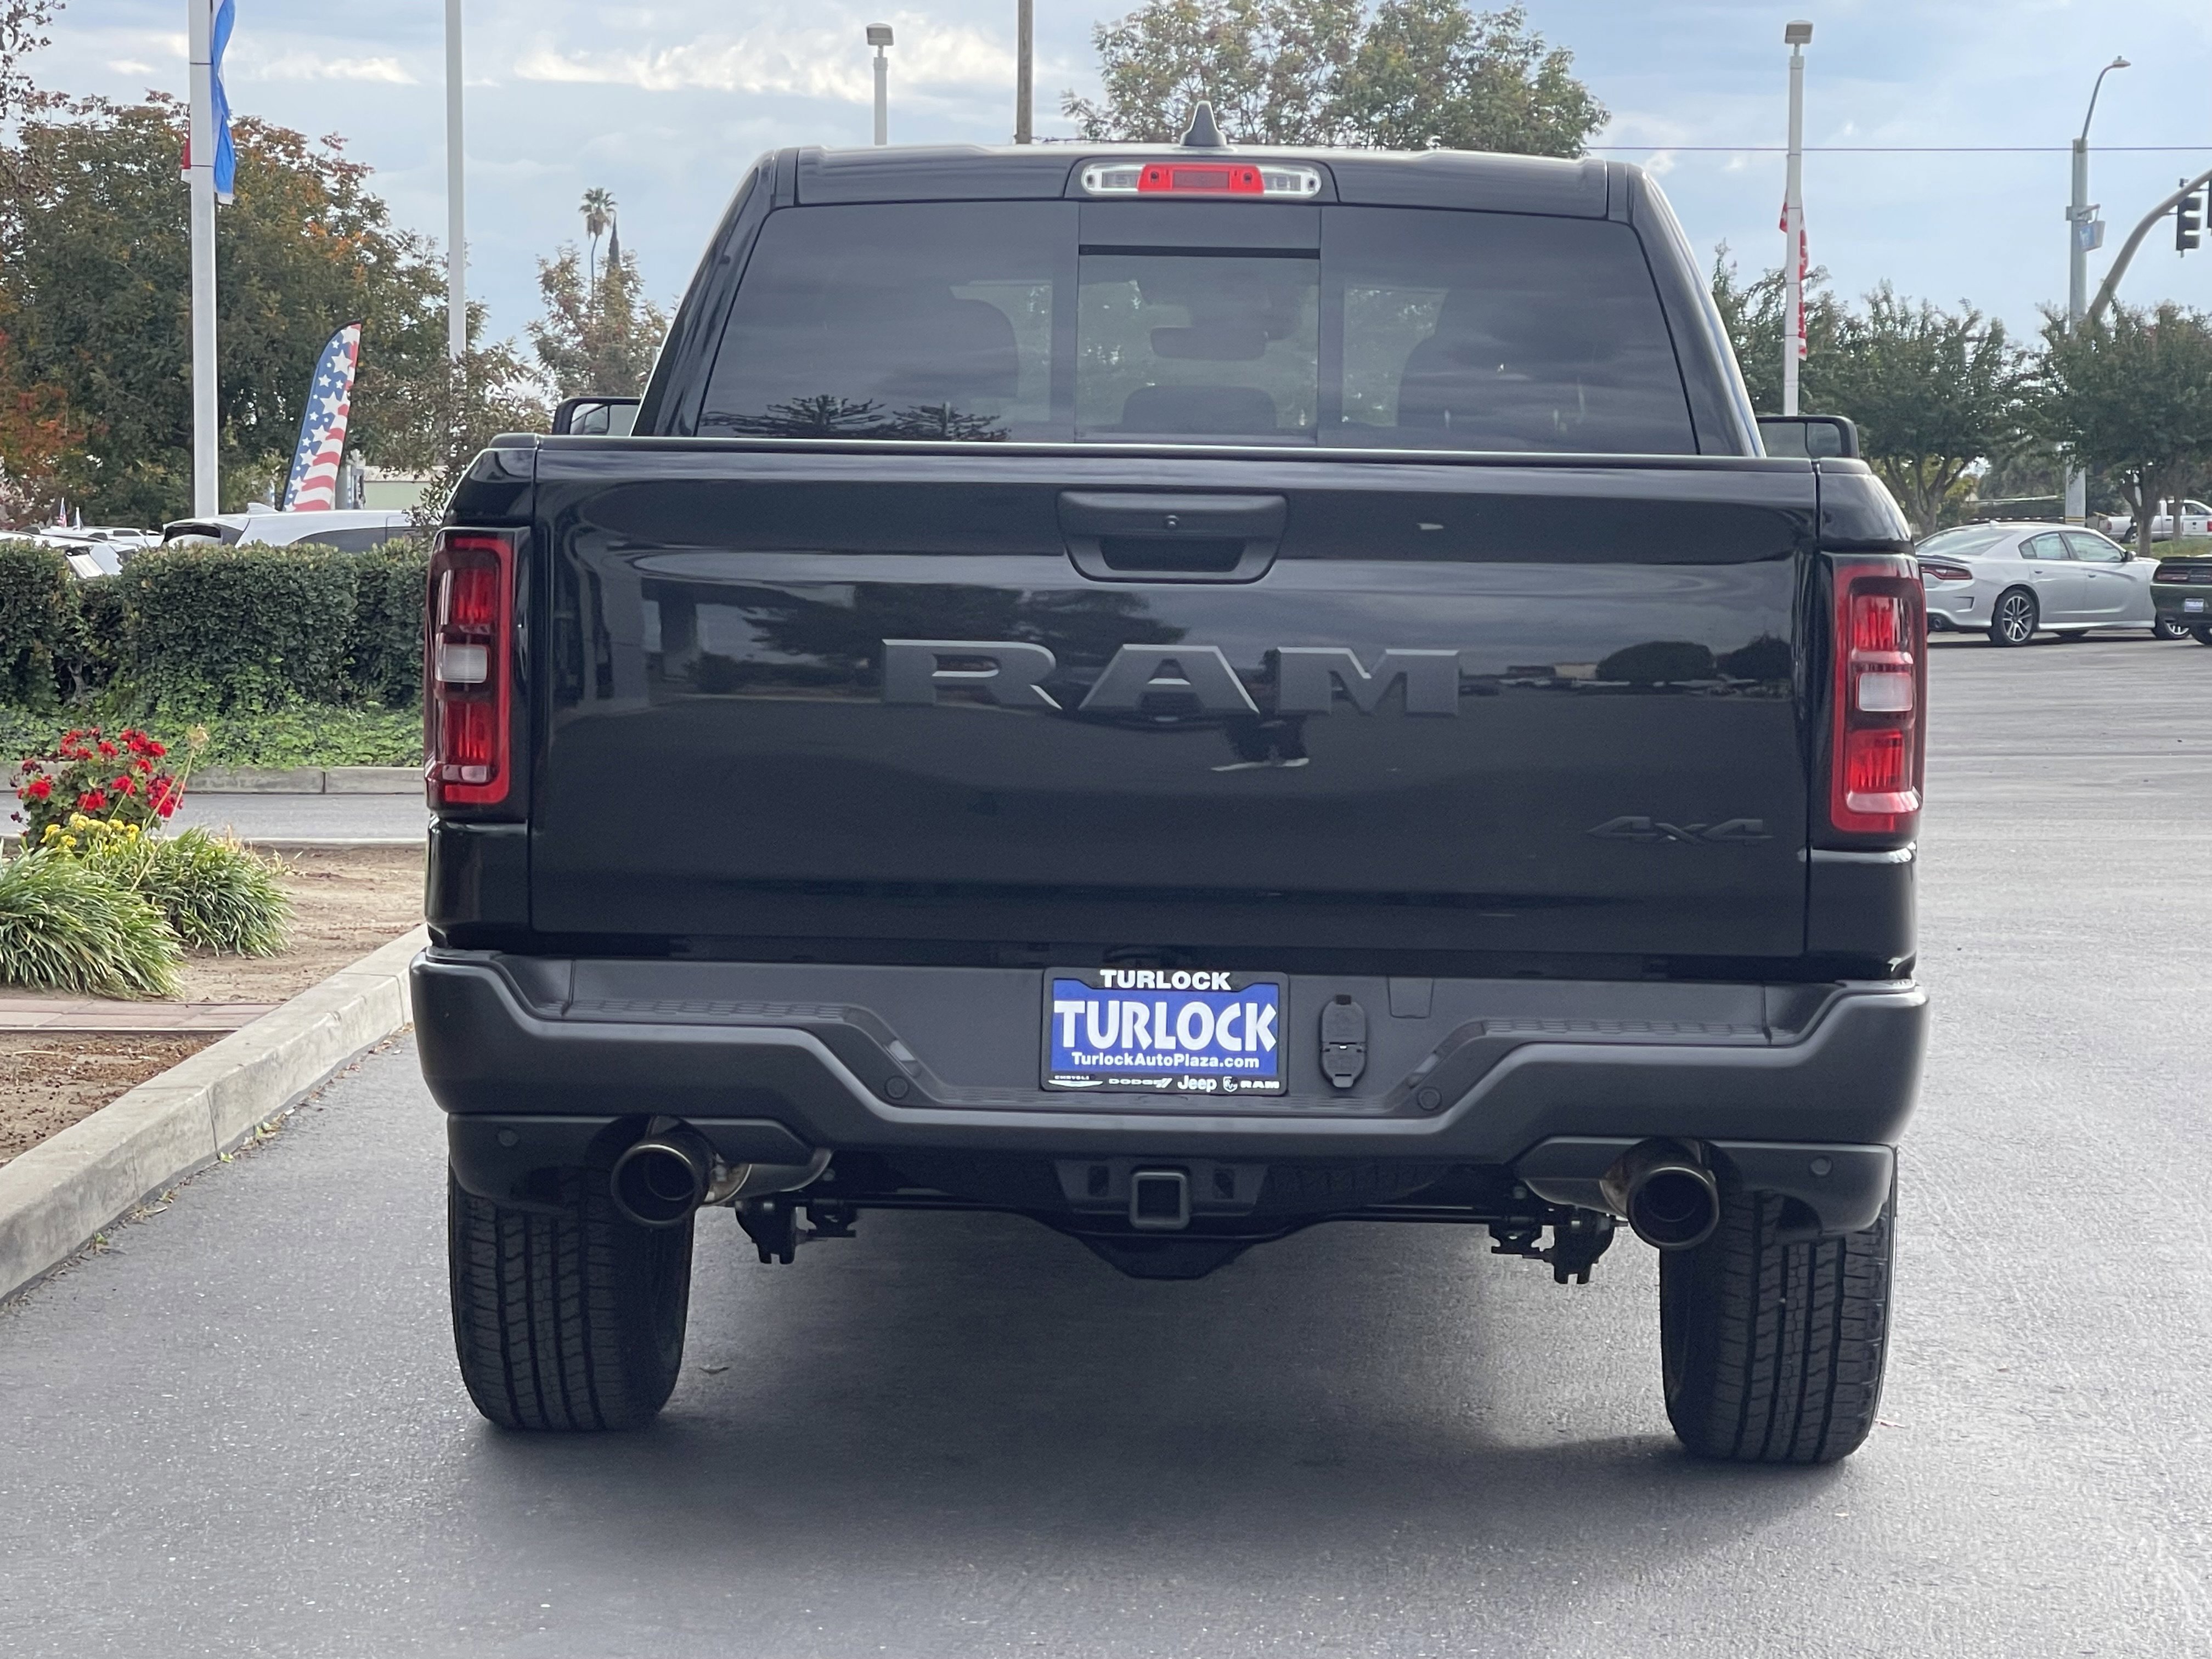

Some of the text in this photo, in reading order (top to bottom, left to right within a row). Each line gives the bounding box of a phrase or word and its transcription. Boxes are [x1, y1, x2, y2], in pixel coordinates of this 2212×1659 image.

[882, 639, 1459, 716] RAM
[1099, 969, 1232, 991] TURLOCK
[1053, 1000, 1277, 1052] TURLOCK
[1071, 1051, 1260, 1068] TurlockAutoPlaza.com
[1177, 1075, 1217, 1093] Jeep
[1240, 1080, 1280, 1089] RAM
